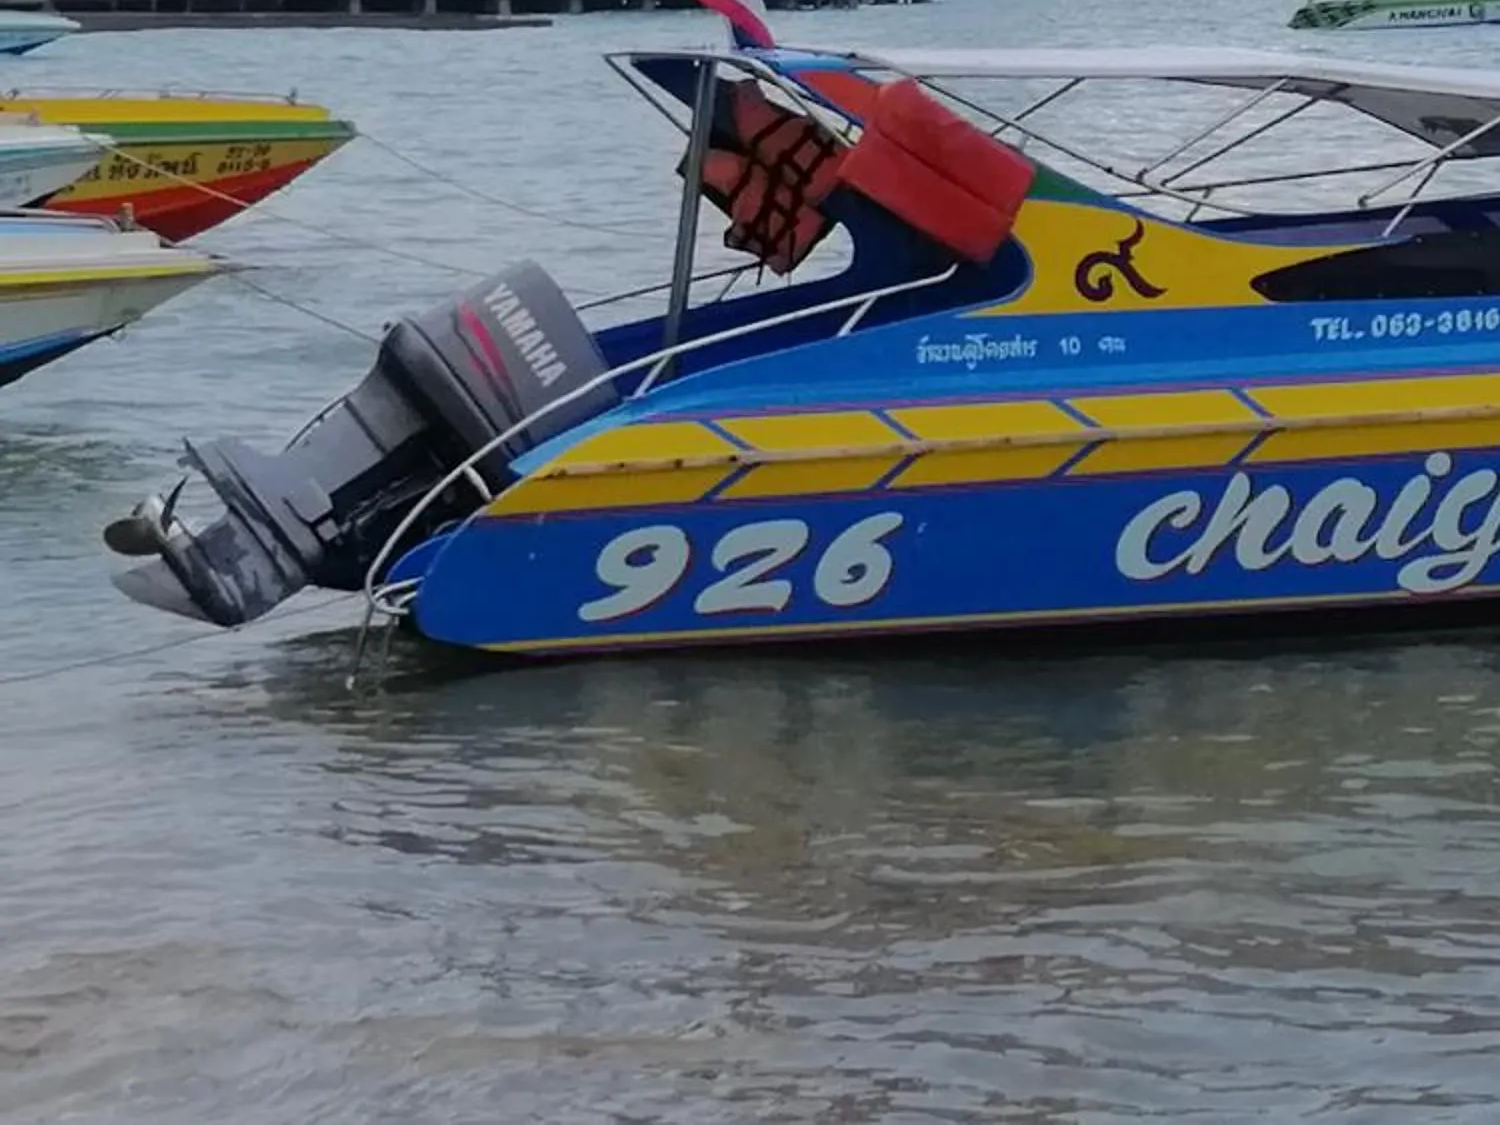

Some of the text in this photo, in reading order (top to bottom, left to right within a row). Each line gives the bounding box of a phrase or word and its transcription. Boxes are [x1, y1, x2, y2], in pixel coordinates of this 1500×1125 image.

[484, 283, 567, 388] YAMAHA
[1059, 335, 1081, 356] 10
[1310, 316, 1363, 341] TEL.
[577, 511, 903, 621] 926
